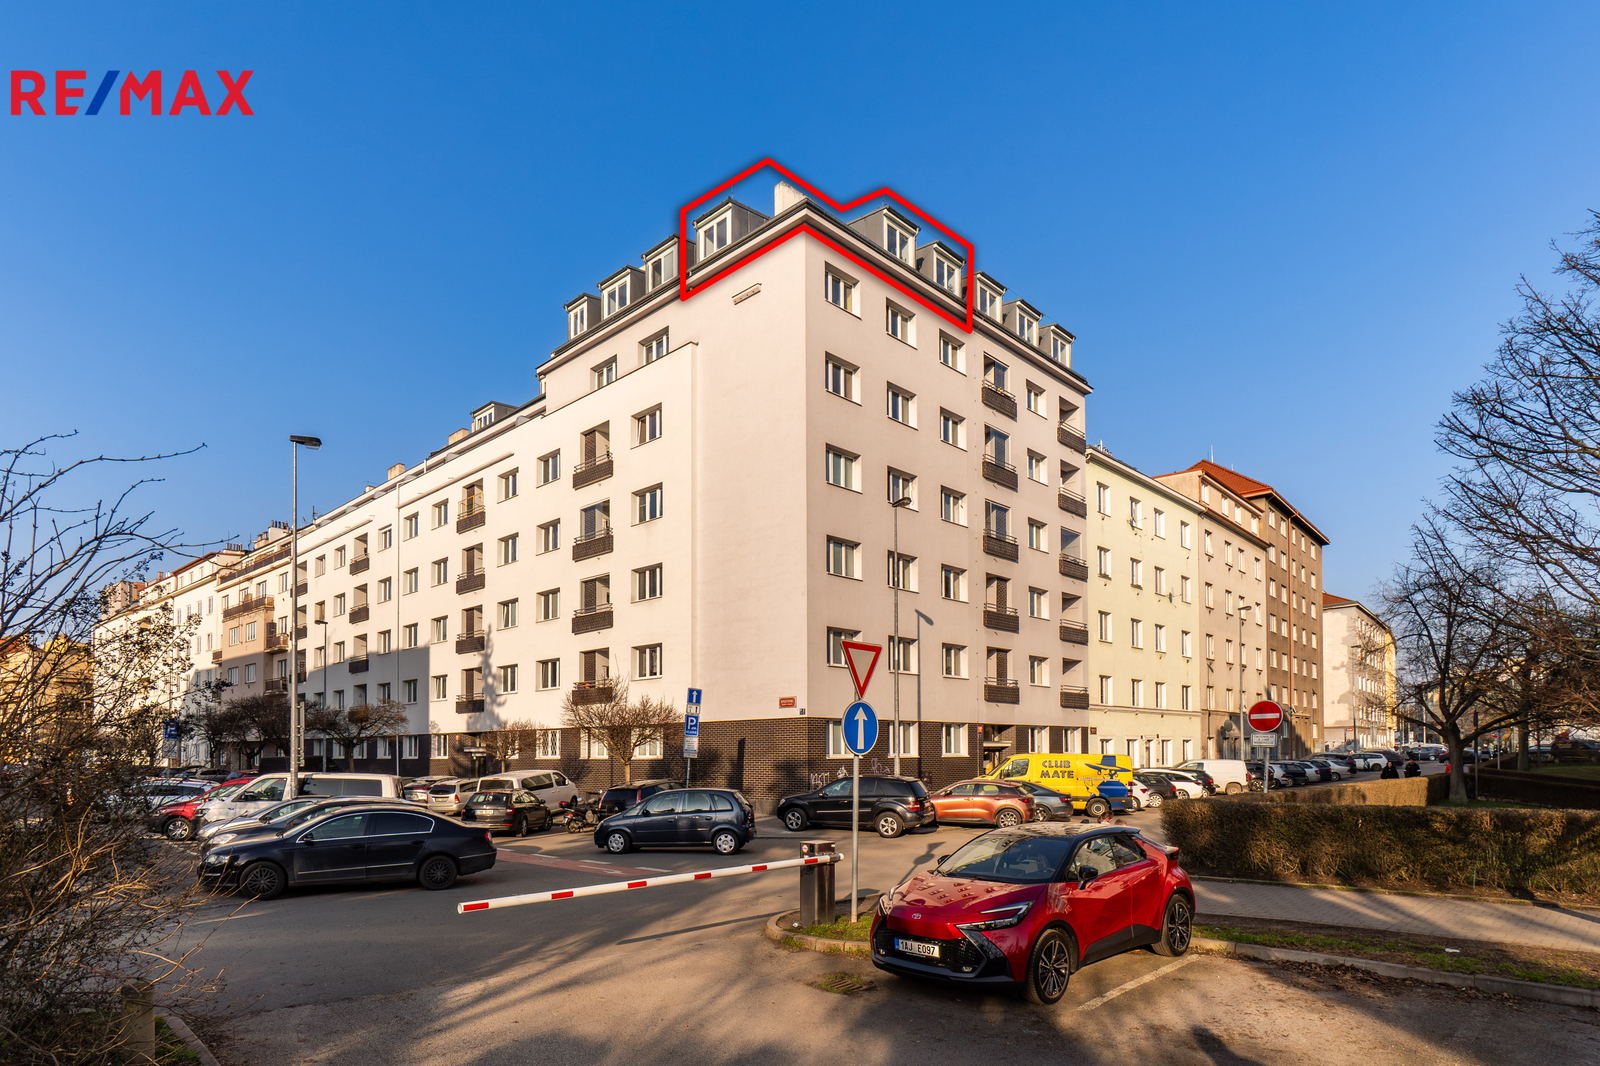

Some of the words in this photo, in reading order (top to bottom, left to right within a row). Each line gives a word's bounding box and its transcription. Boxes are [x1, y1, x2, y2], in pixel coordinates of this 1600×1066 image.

[687, 717, 696, 729] P
[1042, 760, 1070, 768] CLUB
[1040, 770, 1074, 778] MATE
[900, 941, 912, 951] 1AJ
